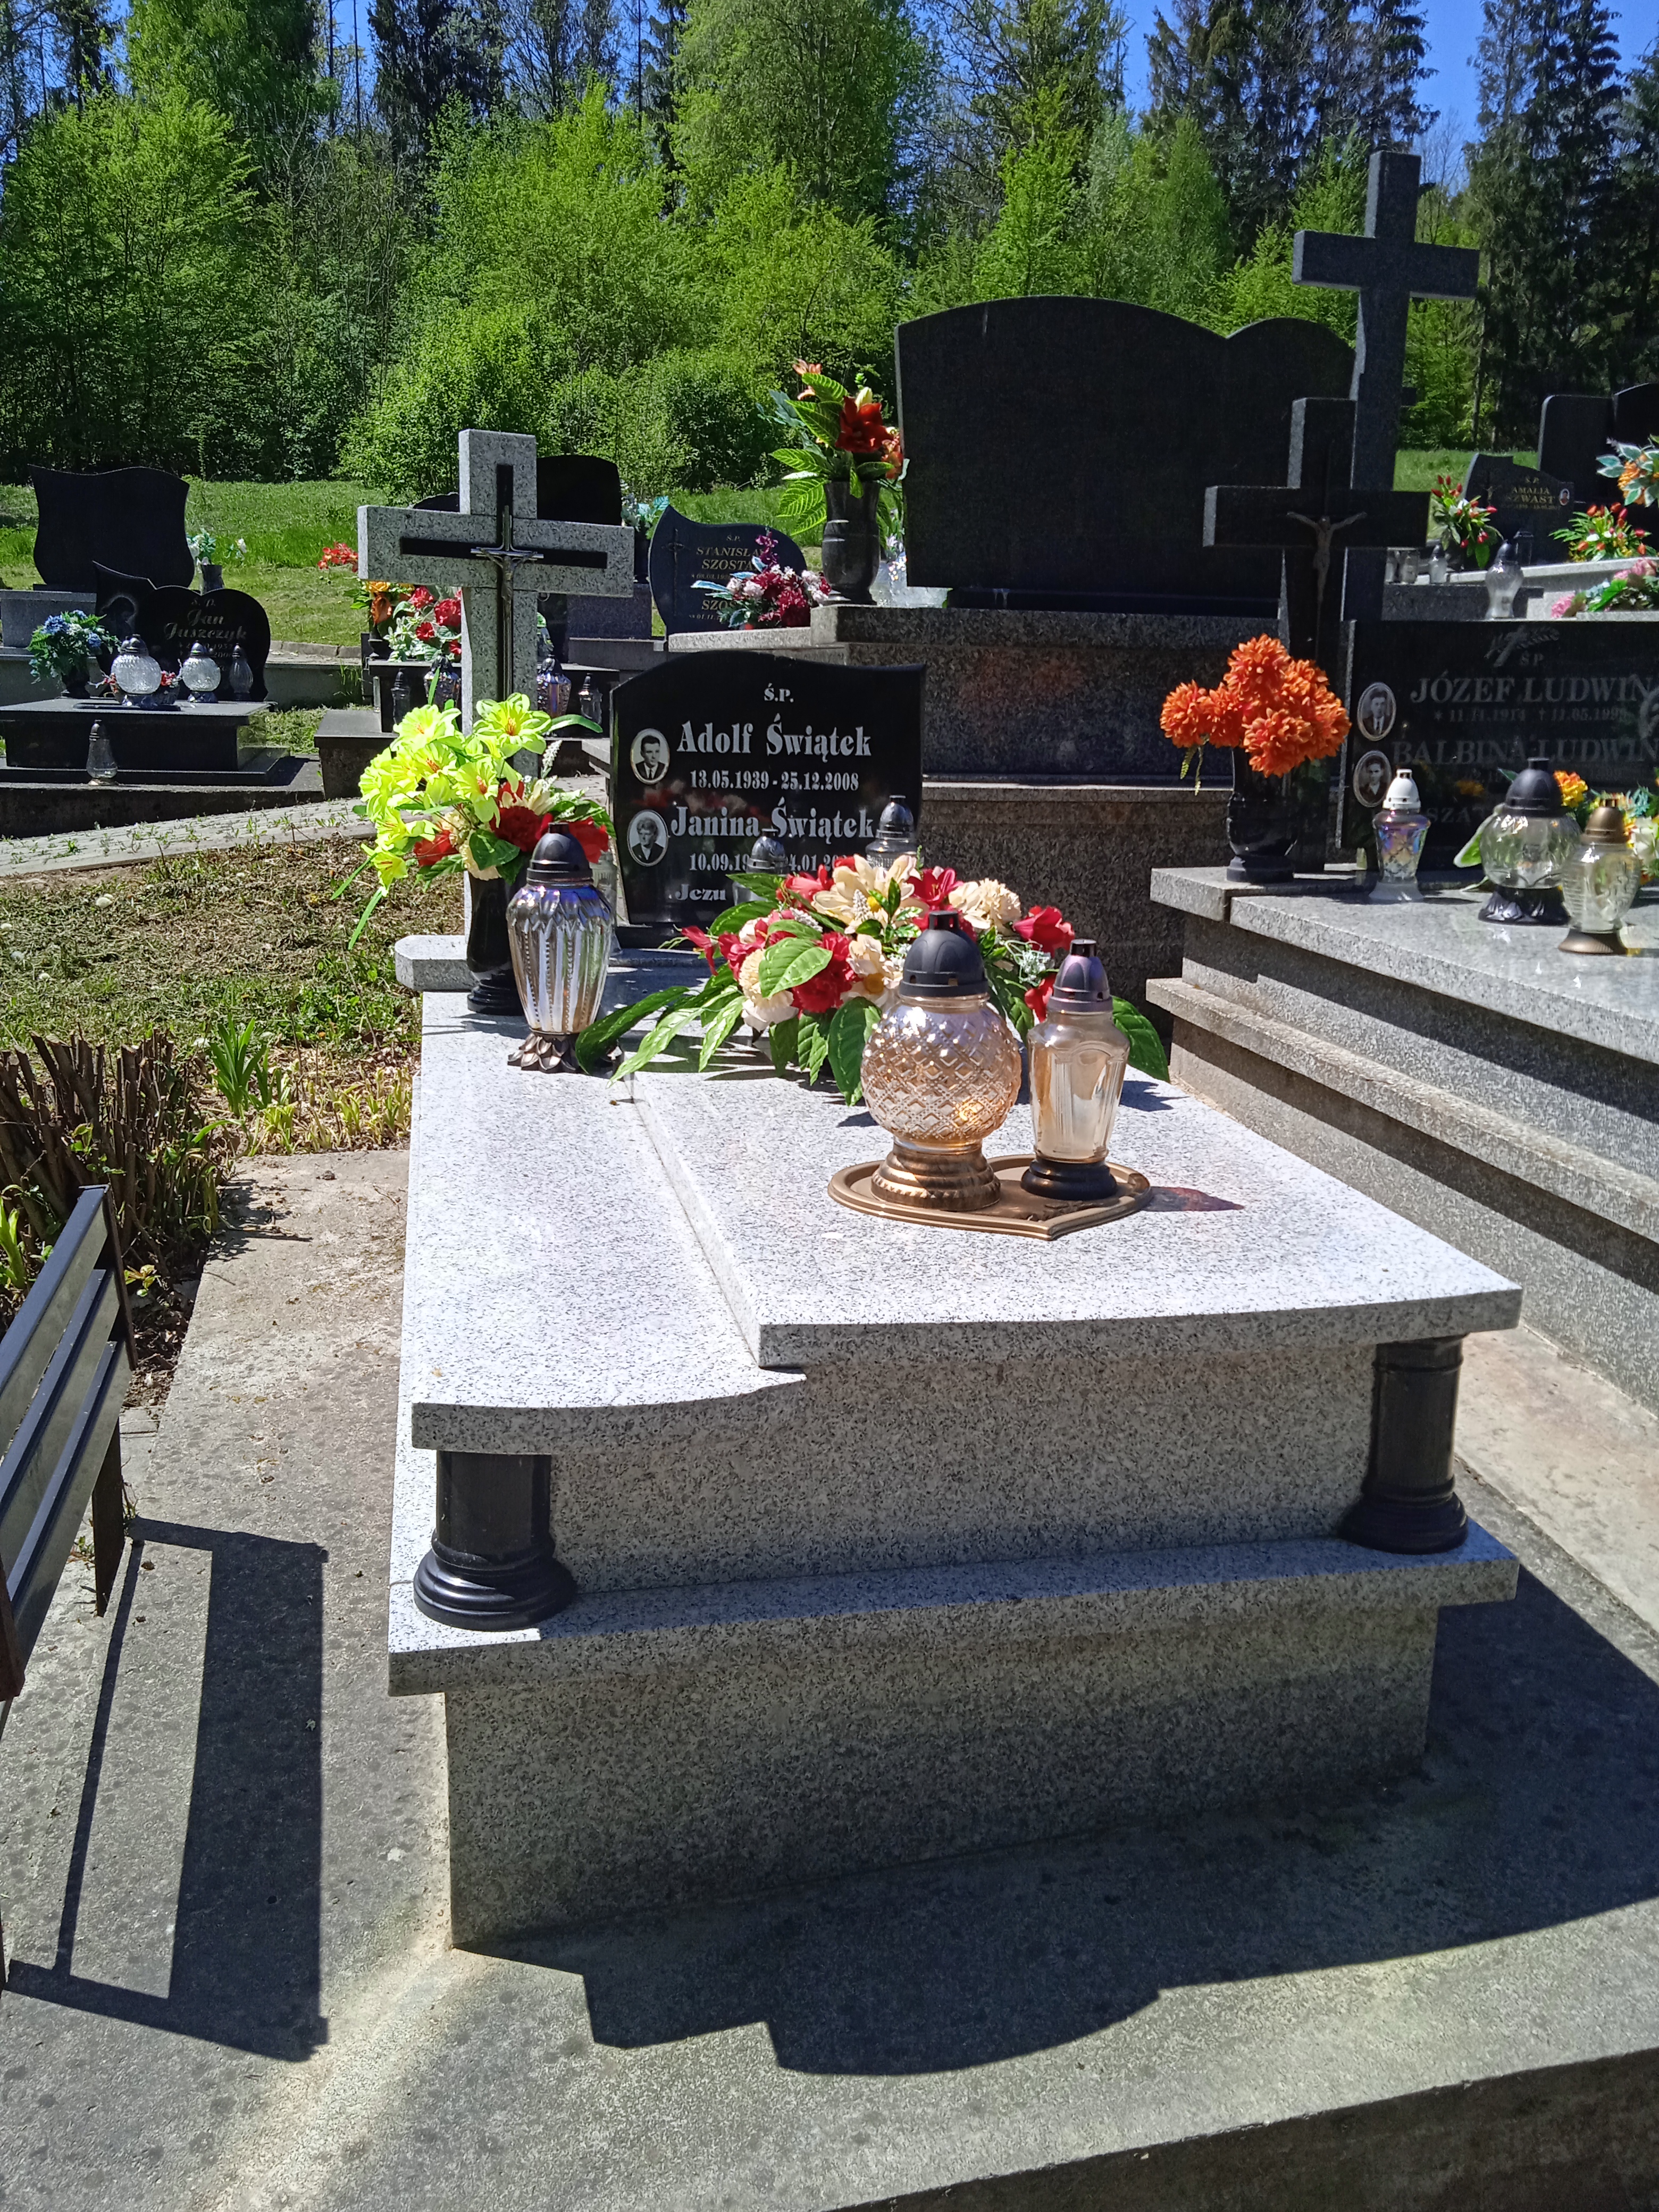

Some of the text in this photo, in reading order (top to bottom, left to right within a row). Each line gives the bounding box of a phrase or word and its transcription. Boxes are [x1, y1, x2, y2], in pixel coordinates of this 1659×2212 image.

[701, 559, 759, 571] SZOSTA
[187, 609, 224, 626] Jan
[1410, 669, 1515, 703] JÓZEF
[676, 712, 872, 763] Adolf Świątek
[1392, 740, 1527, 765] BALBINA
[690, 769, 769, 789] 13.05.1939
[781, 771, 859, 791] 25.12.2008
[670, 797, 874, 844] Janina Świątek
[689, 853, 750, 872] 10.09.19
[675, 884, 726, 901] Jezu
